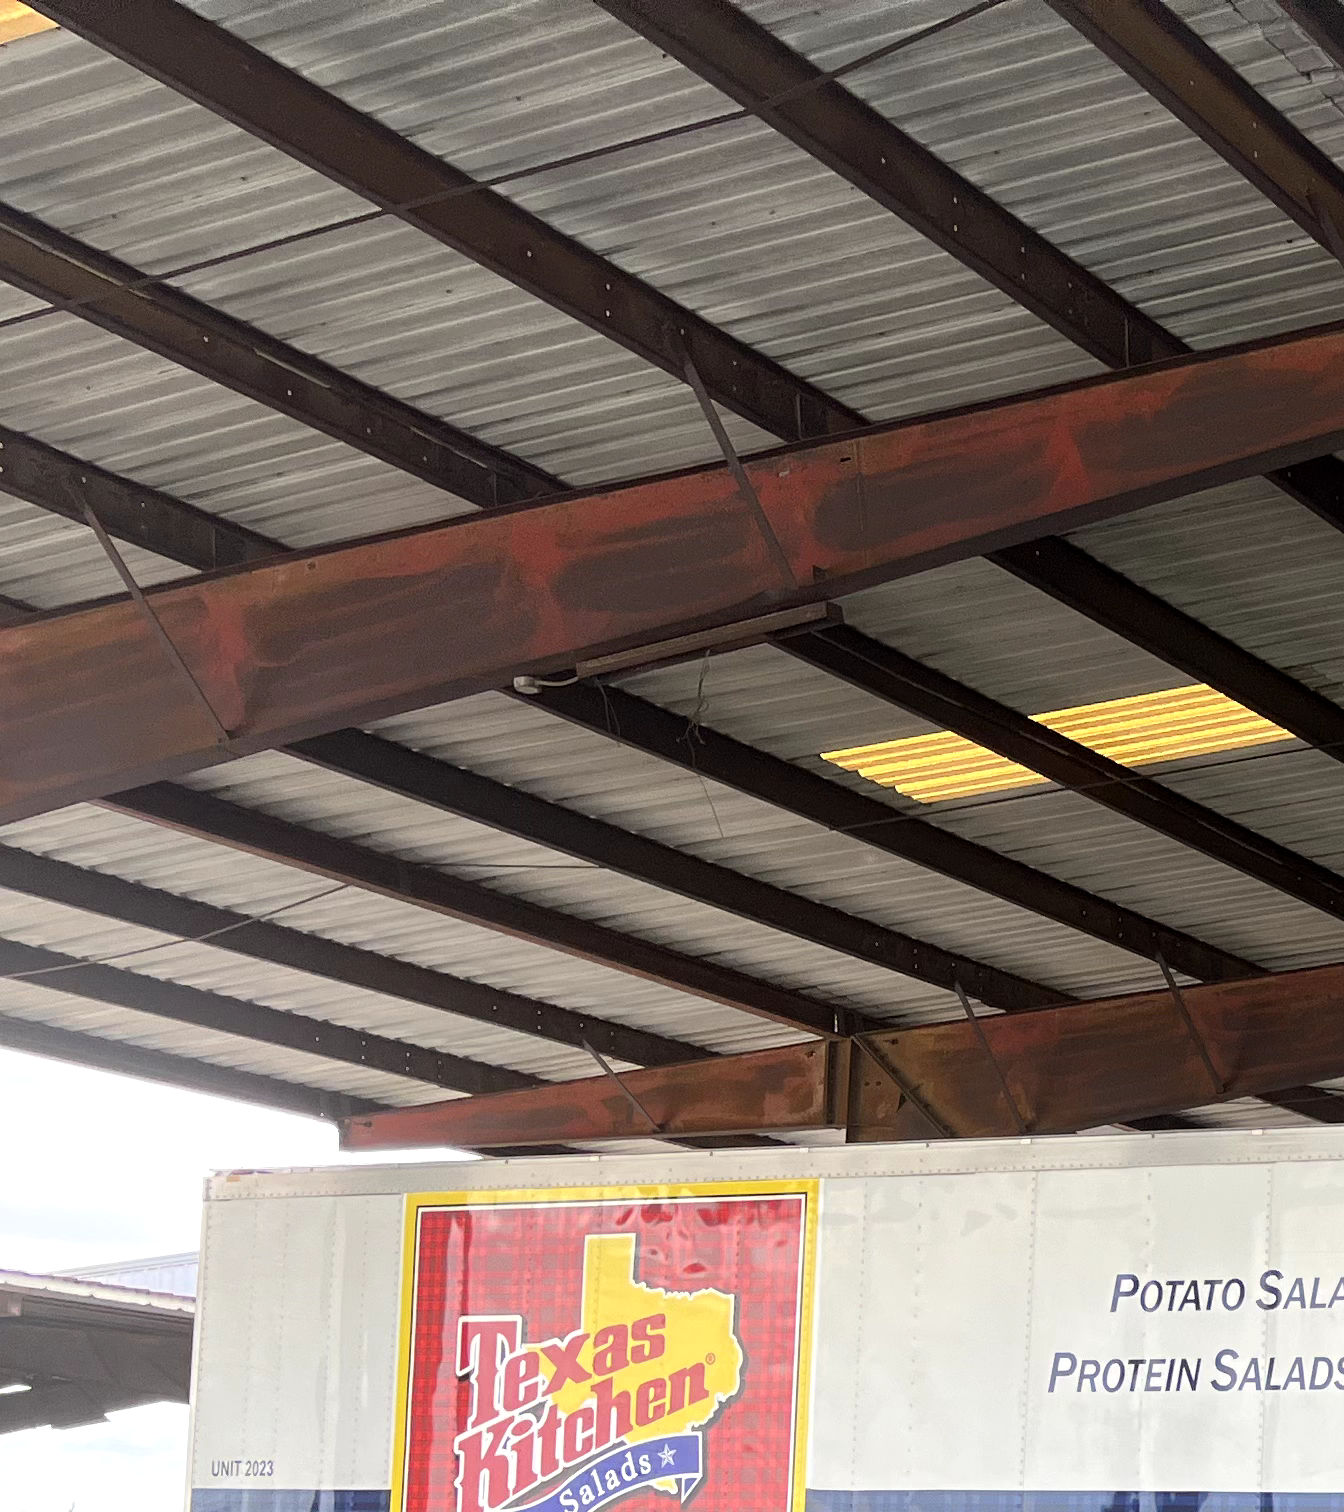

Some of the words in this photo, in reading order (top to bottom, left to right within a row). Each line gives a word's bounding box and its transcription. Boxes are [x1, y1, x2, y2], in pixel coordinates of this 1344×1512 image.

[1109, 1273, 1246, 1313] POTATO
[457, 1313, 667, 1432] Texas
[1047, 1352, 1203, 1393] PROTEIN
[211, 1459, 242, 1477] UNIT
[244, 1459, 275, 1477] 2023
